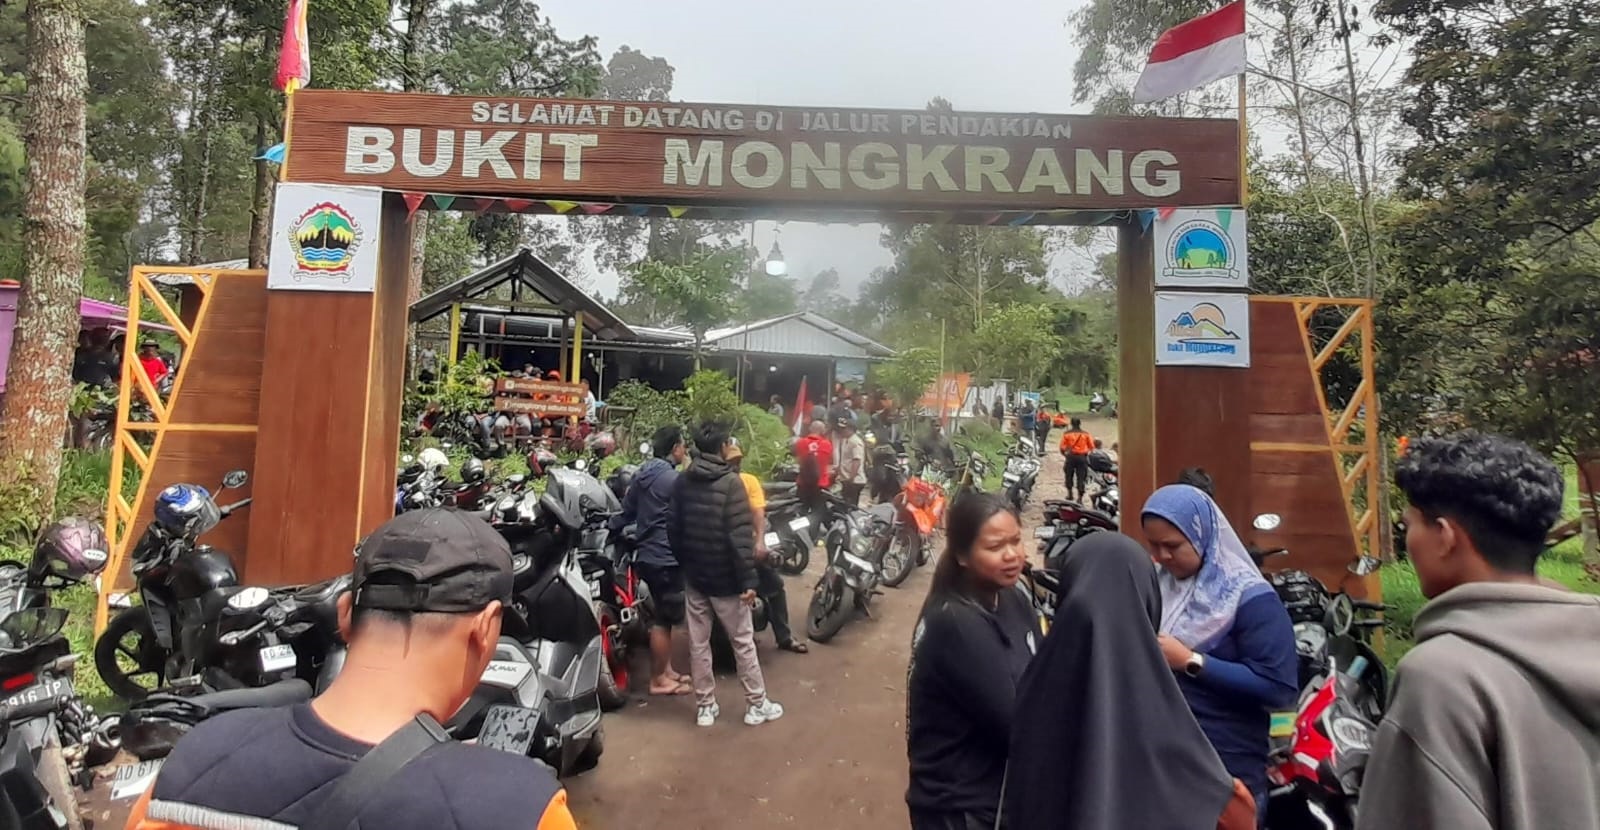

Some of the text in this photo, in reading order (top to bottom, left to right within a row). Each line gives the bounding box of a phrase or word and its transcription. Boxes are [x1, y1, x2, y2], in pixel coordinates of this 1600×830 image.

[471, 101, 1072, 140] SELAMAT DATANG DI JALUR PENDAKIAN
[344, 125, 1182, 197] BUKIT MONGKRANG
[117, 764, 133, 781] AD
